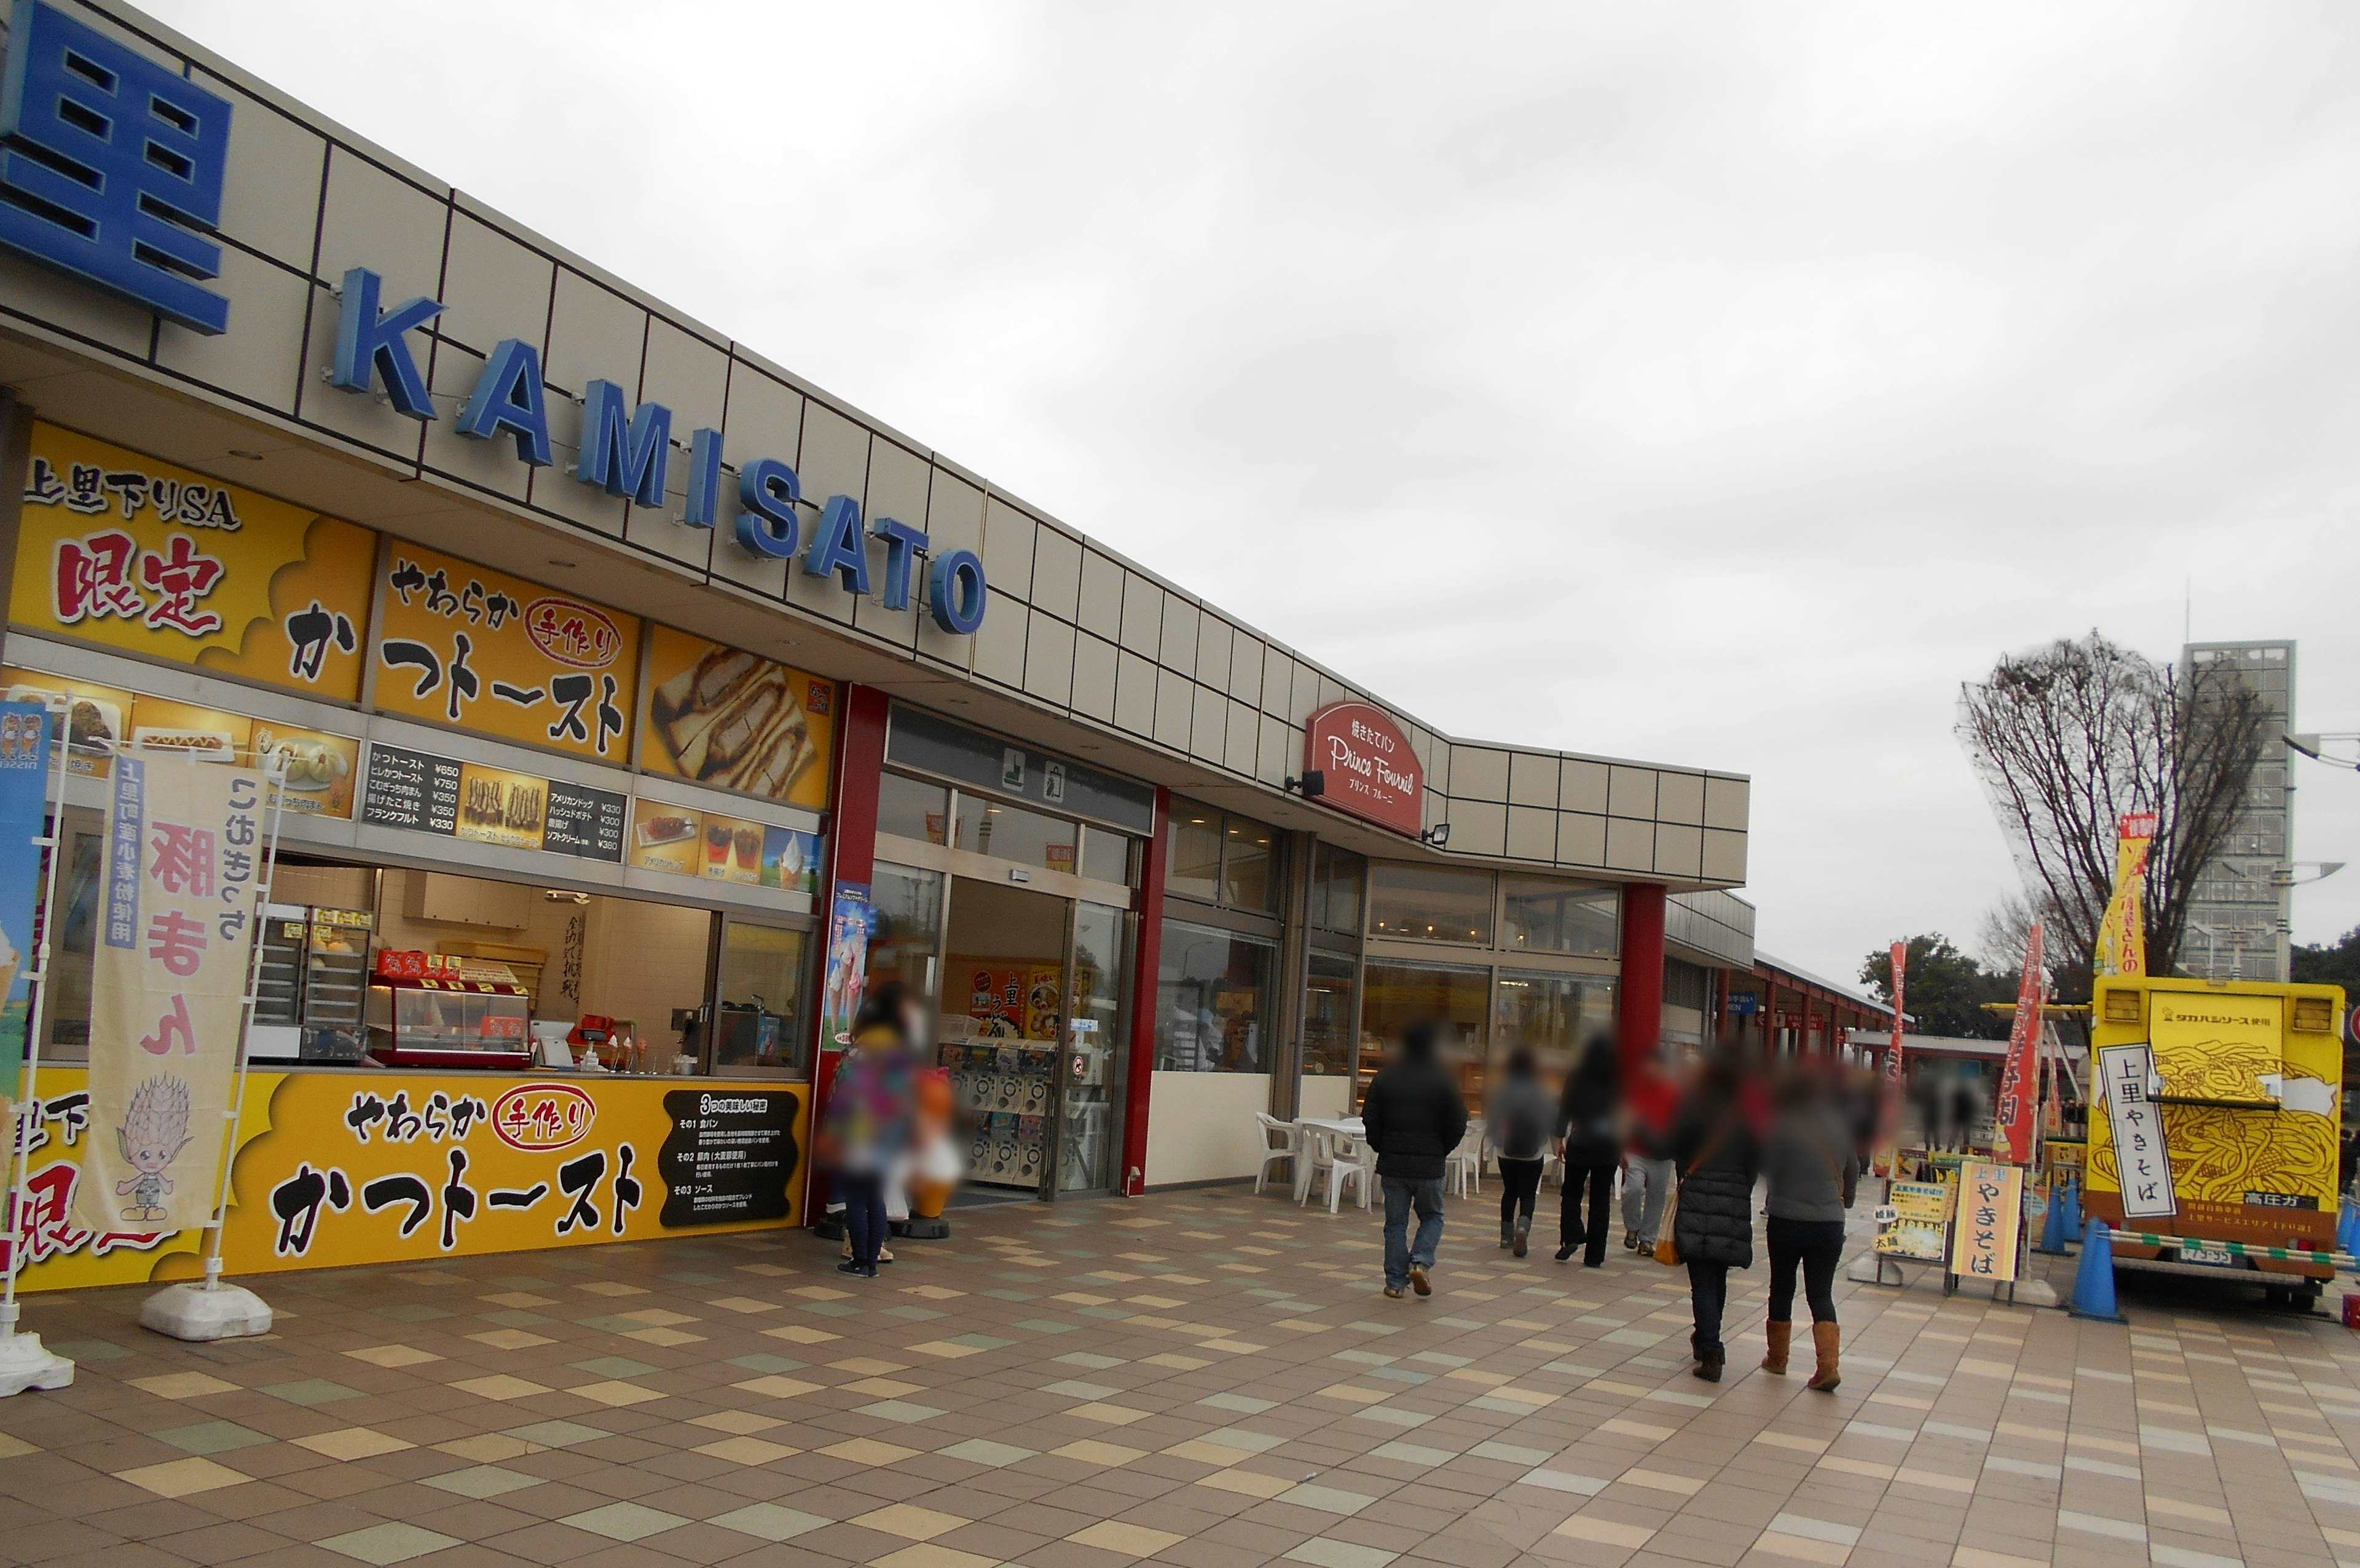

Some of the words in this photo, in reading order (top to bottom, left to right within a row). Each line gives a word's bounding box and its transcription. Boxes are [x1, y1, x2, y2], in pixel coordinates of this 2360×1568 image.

[330, 267, 987, 635] KAMISATO
[25, 458, 240, 530] 上里下りSA
[54, 530, 223, 635] 限定
[390, 558, 519, 630] やわらか
[533, 610, 613, 661] 手作り
[1351, 719, 1394, 753] 焼きたてパン
[371, 752, 425, 770] かつトースト
[435, 764, 459, 777] ¥650
[1328, 735, 1372, 777] Prince
[1374, 756, 1414, 796] Fournil
[371, 766, 423, 783] ヒレかつトースト
[434, 777, 458, 790] ¥750
[1350, 778, 1369, 795] プリンス
[369, 780, 422, 798] こむぎっち肉まん
[433, 791, 456, 804] ¥350
[551, 793, 593, 809] アメリカンドッグ
[601, 802, 621, 814] ¥330
[367, 807, 419, 824] フランクフルト
[430, 817, 454, 829] ¥330
[431, 804, 455, 817] ¥350
[549, 806, 592, 821] ハッシュドポテト
[600, 815, 620, 826] ¥300
[599, 827, 618, 839] ¥300
[1004, 971, 1020, 1006] 上里
[2176, 1014, 2249, 1025] タカハシソース
[345, 1090, 487, 1142] やわらか
[502, 1097, 586, 1140] 手作り
[680, 1119, 696, 1129] その1
[699, 1119, 718, 1129] 食パン
[2117, 1058, 2158, 1202] 上里やきそば
[677, 1153, 694, 1162] その2
[1976, 1167, 2007, 1181] 上里
[272, 1144, 643, 1256] かつトースト
[674, 1185, 691, 1195] その3
[695, 1184, 713, 1193] ソース
[1971, 1182, 2000, 1274] やきそば
